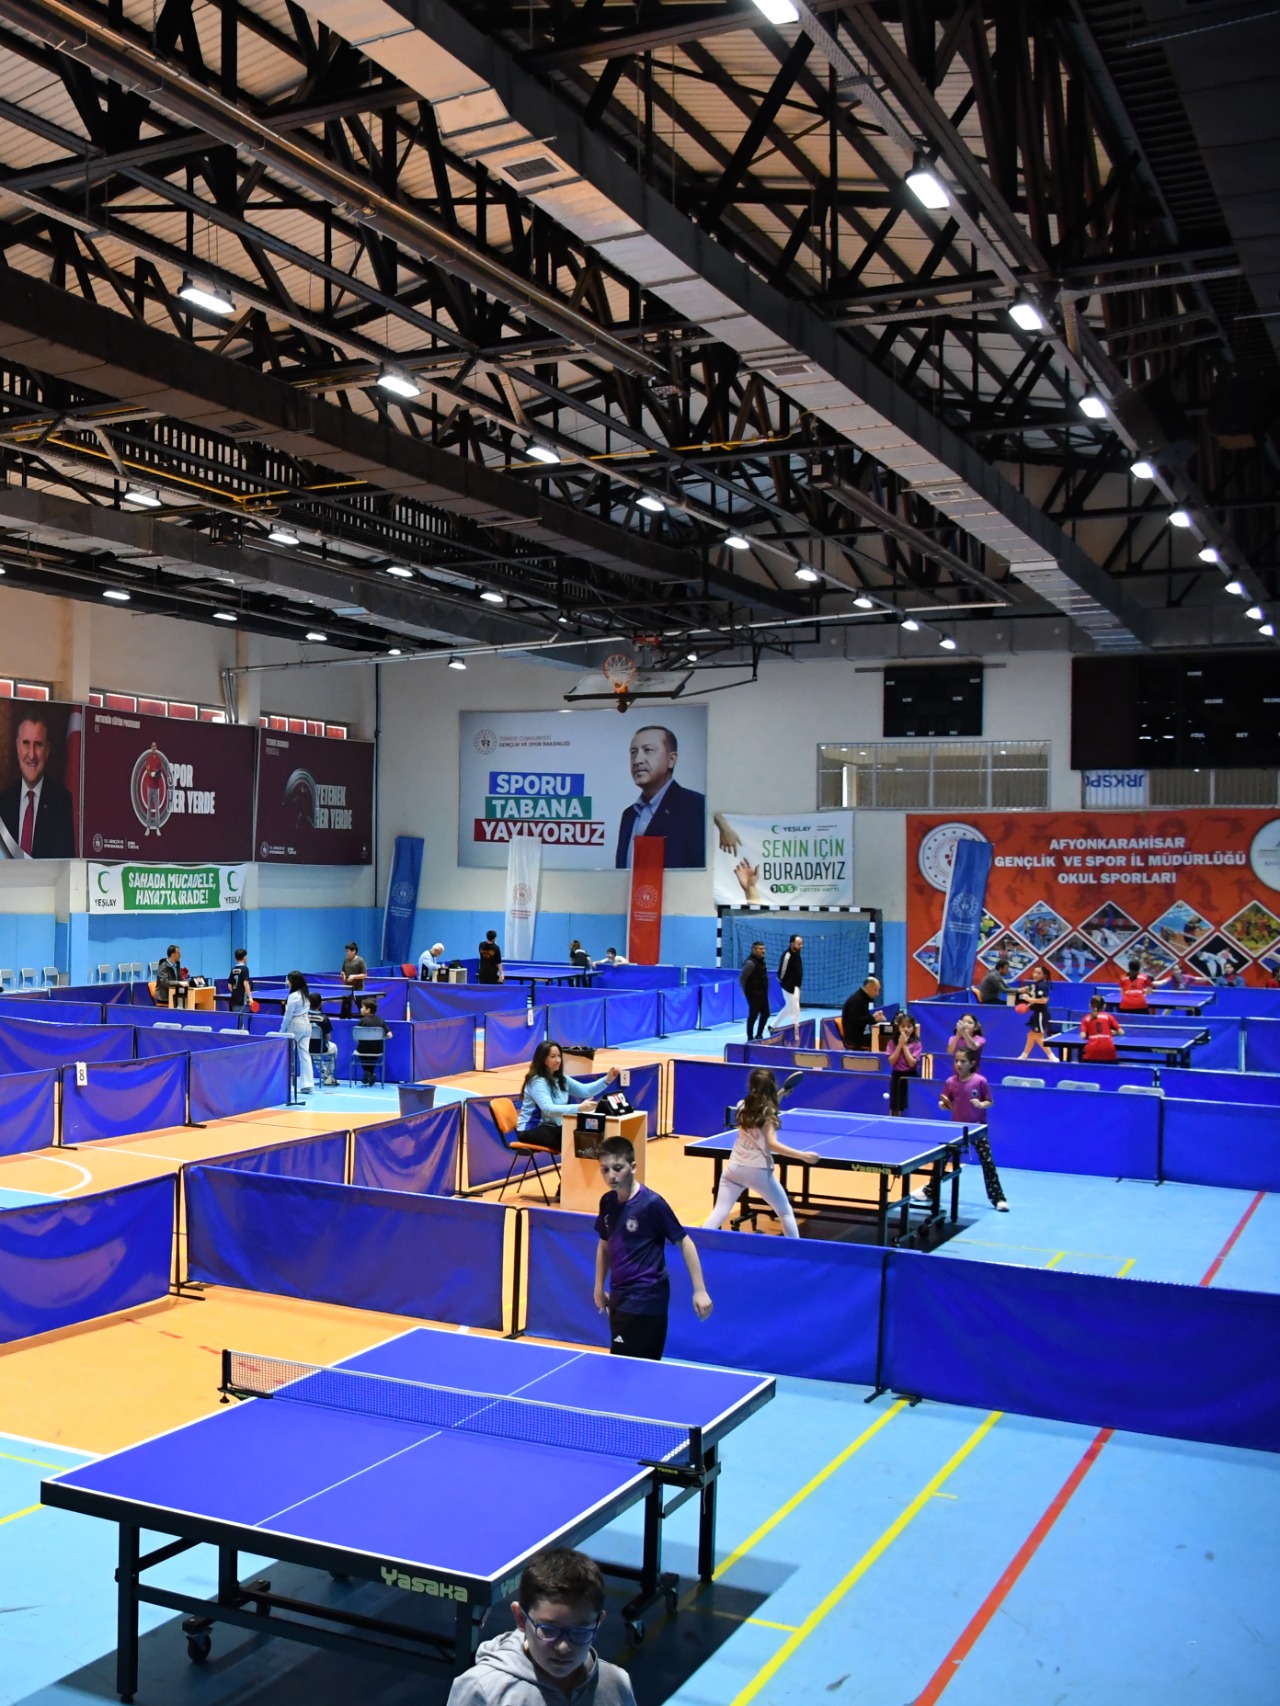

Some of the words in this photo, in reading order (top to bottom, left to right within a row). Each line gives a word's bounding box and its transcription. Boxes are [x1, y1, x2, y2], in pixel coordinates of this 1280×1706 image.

[167, 762, 194, 788] SPOR
[496, 774, 571, 796] SPORU
[167, 789, 185, 813] HER
[187, 790, 216, 814] YERDE
[491, 798, 584, 819] TABANA
[330, 808, 353, 830] YERDE
[481, 821, 605, 843] YAYIYORUZ
[762, 835, 808, 858] SENİN
[814, 834, 845, 860] İÇİN
[1049, 836, 1186, 851] AFYONKARAHİSAR
[994, 853, 1056, 869] GENÇLİK
[1063, 854, 1082, 867] VE
[1085, 853, 1127, 867] SPOR
[1130, 851, 1145, 867] İL
[1148, 849, 1246, 867] MÜDÜRLÜĞÜ
[128, 872, 167, 889] SAHADA
[762, 861, 846, 881] BURADAYIZ
[1057, 872, 1097, 885] OKUL
[1100, 871, 1177, 884] SPORLARI
[135, 889, 180, 905] HAYATTA
[178, 889, 209, 905] İRADE!
[79, 1069, 84, 1081] 8
[381, 1566, 468, 1603] Yasaka
